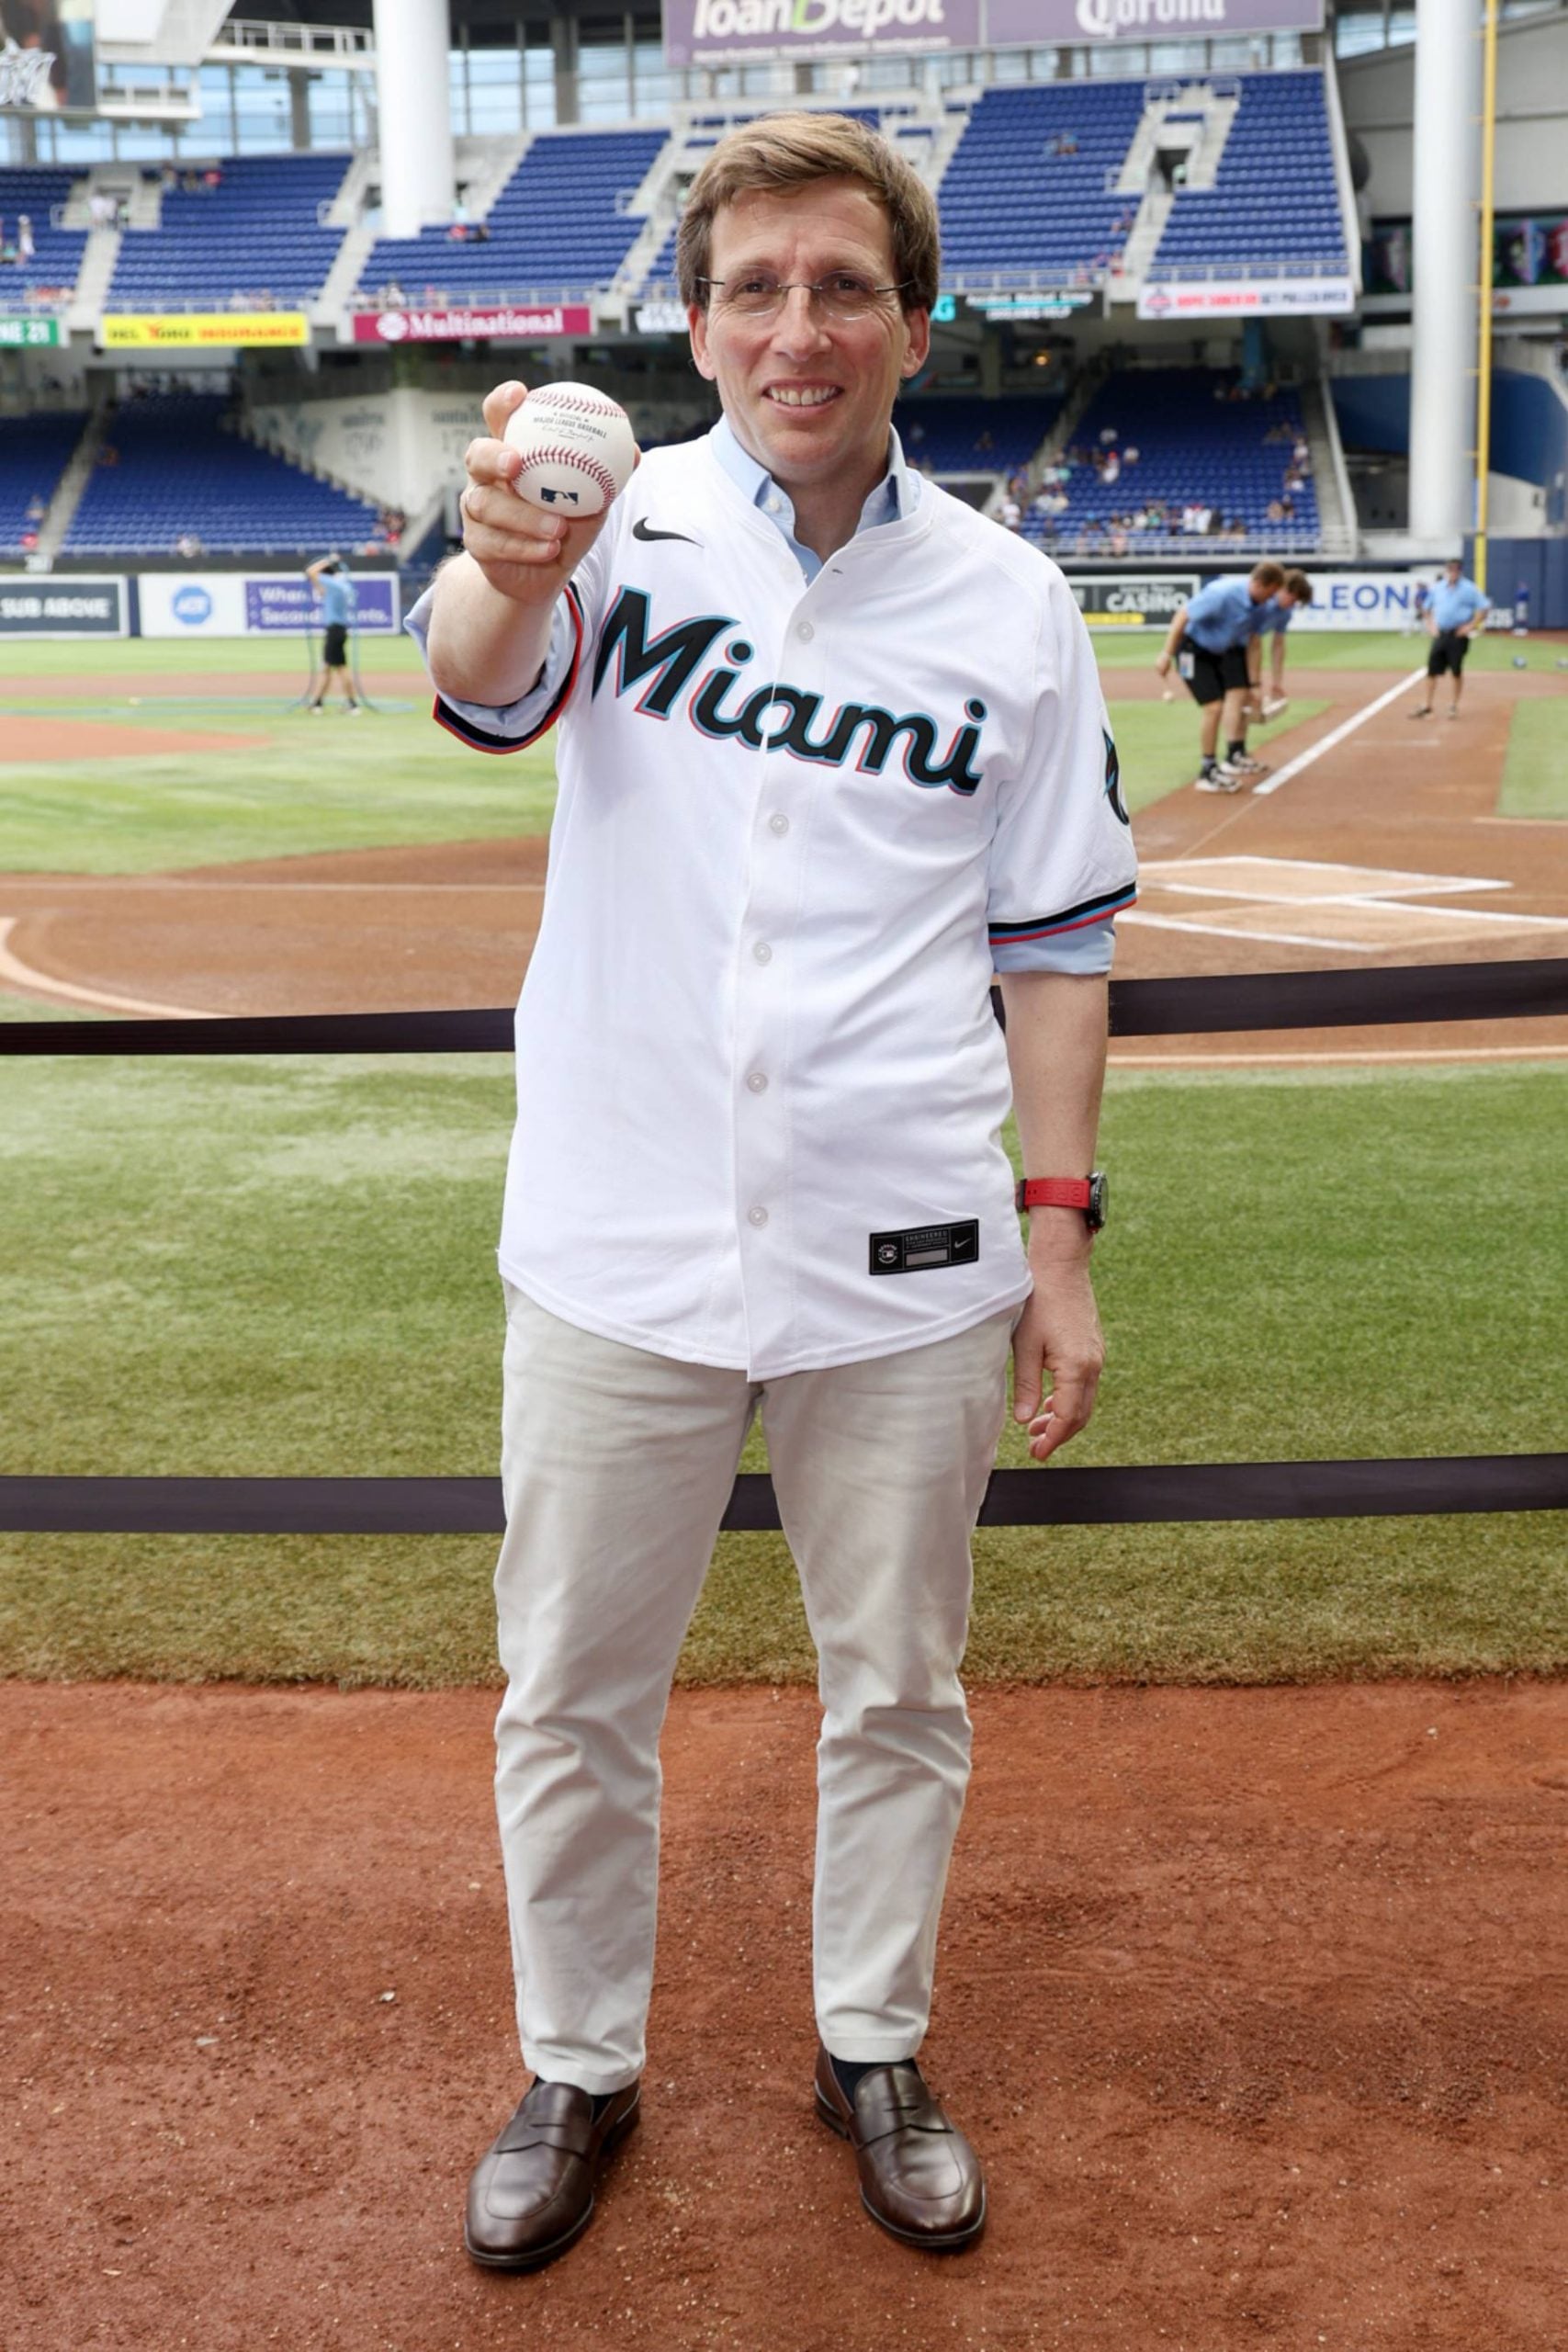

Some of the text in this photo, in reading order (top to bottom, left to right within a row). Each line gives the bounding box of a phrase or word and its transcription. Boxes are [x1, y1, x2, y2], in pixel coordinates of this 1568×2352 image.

[693, 0, 945, 38] loanDepot
[1076, 0, 1225, 38] Corona
[410, 310, 563, 337] Multinational
[0, 597, 110, 618] SUB ABOVE
[1106, 592, 1189, 613] CASINO
[592, 584, 984, 797] Miami
